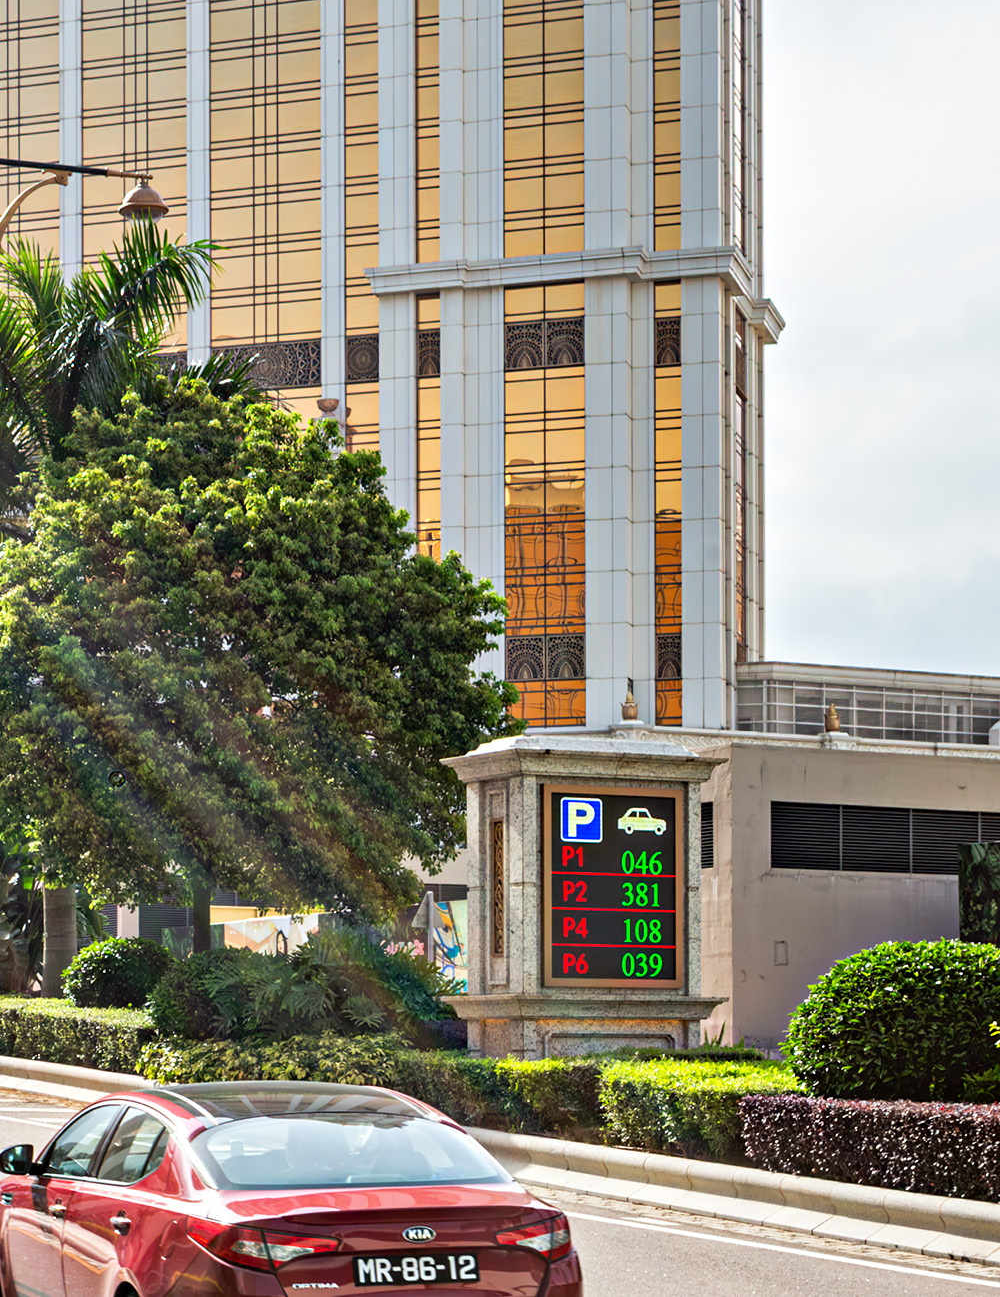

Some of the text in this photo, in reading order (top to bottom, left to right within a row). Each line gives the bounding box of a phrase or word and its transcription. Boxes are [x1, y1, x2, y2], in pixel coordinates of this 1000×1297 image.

[568, 802, 595, 838] P
[562, 846, 663, 875] P1 046
[562, 881, 660, 907] P2 381
[562, 917, 662, 943] P4 108
[562, 953, 663, 977] P6 039
[408, 1227, 432, 1240] KIA
[357, 1255, 478, 1283] MR-86-12
[292, 1282, 340, 1290] OPTIMA
